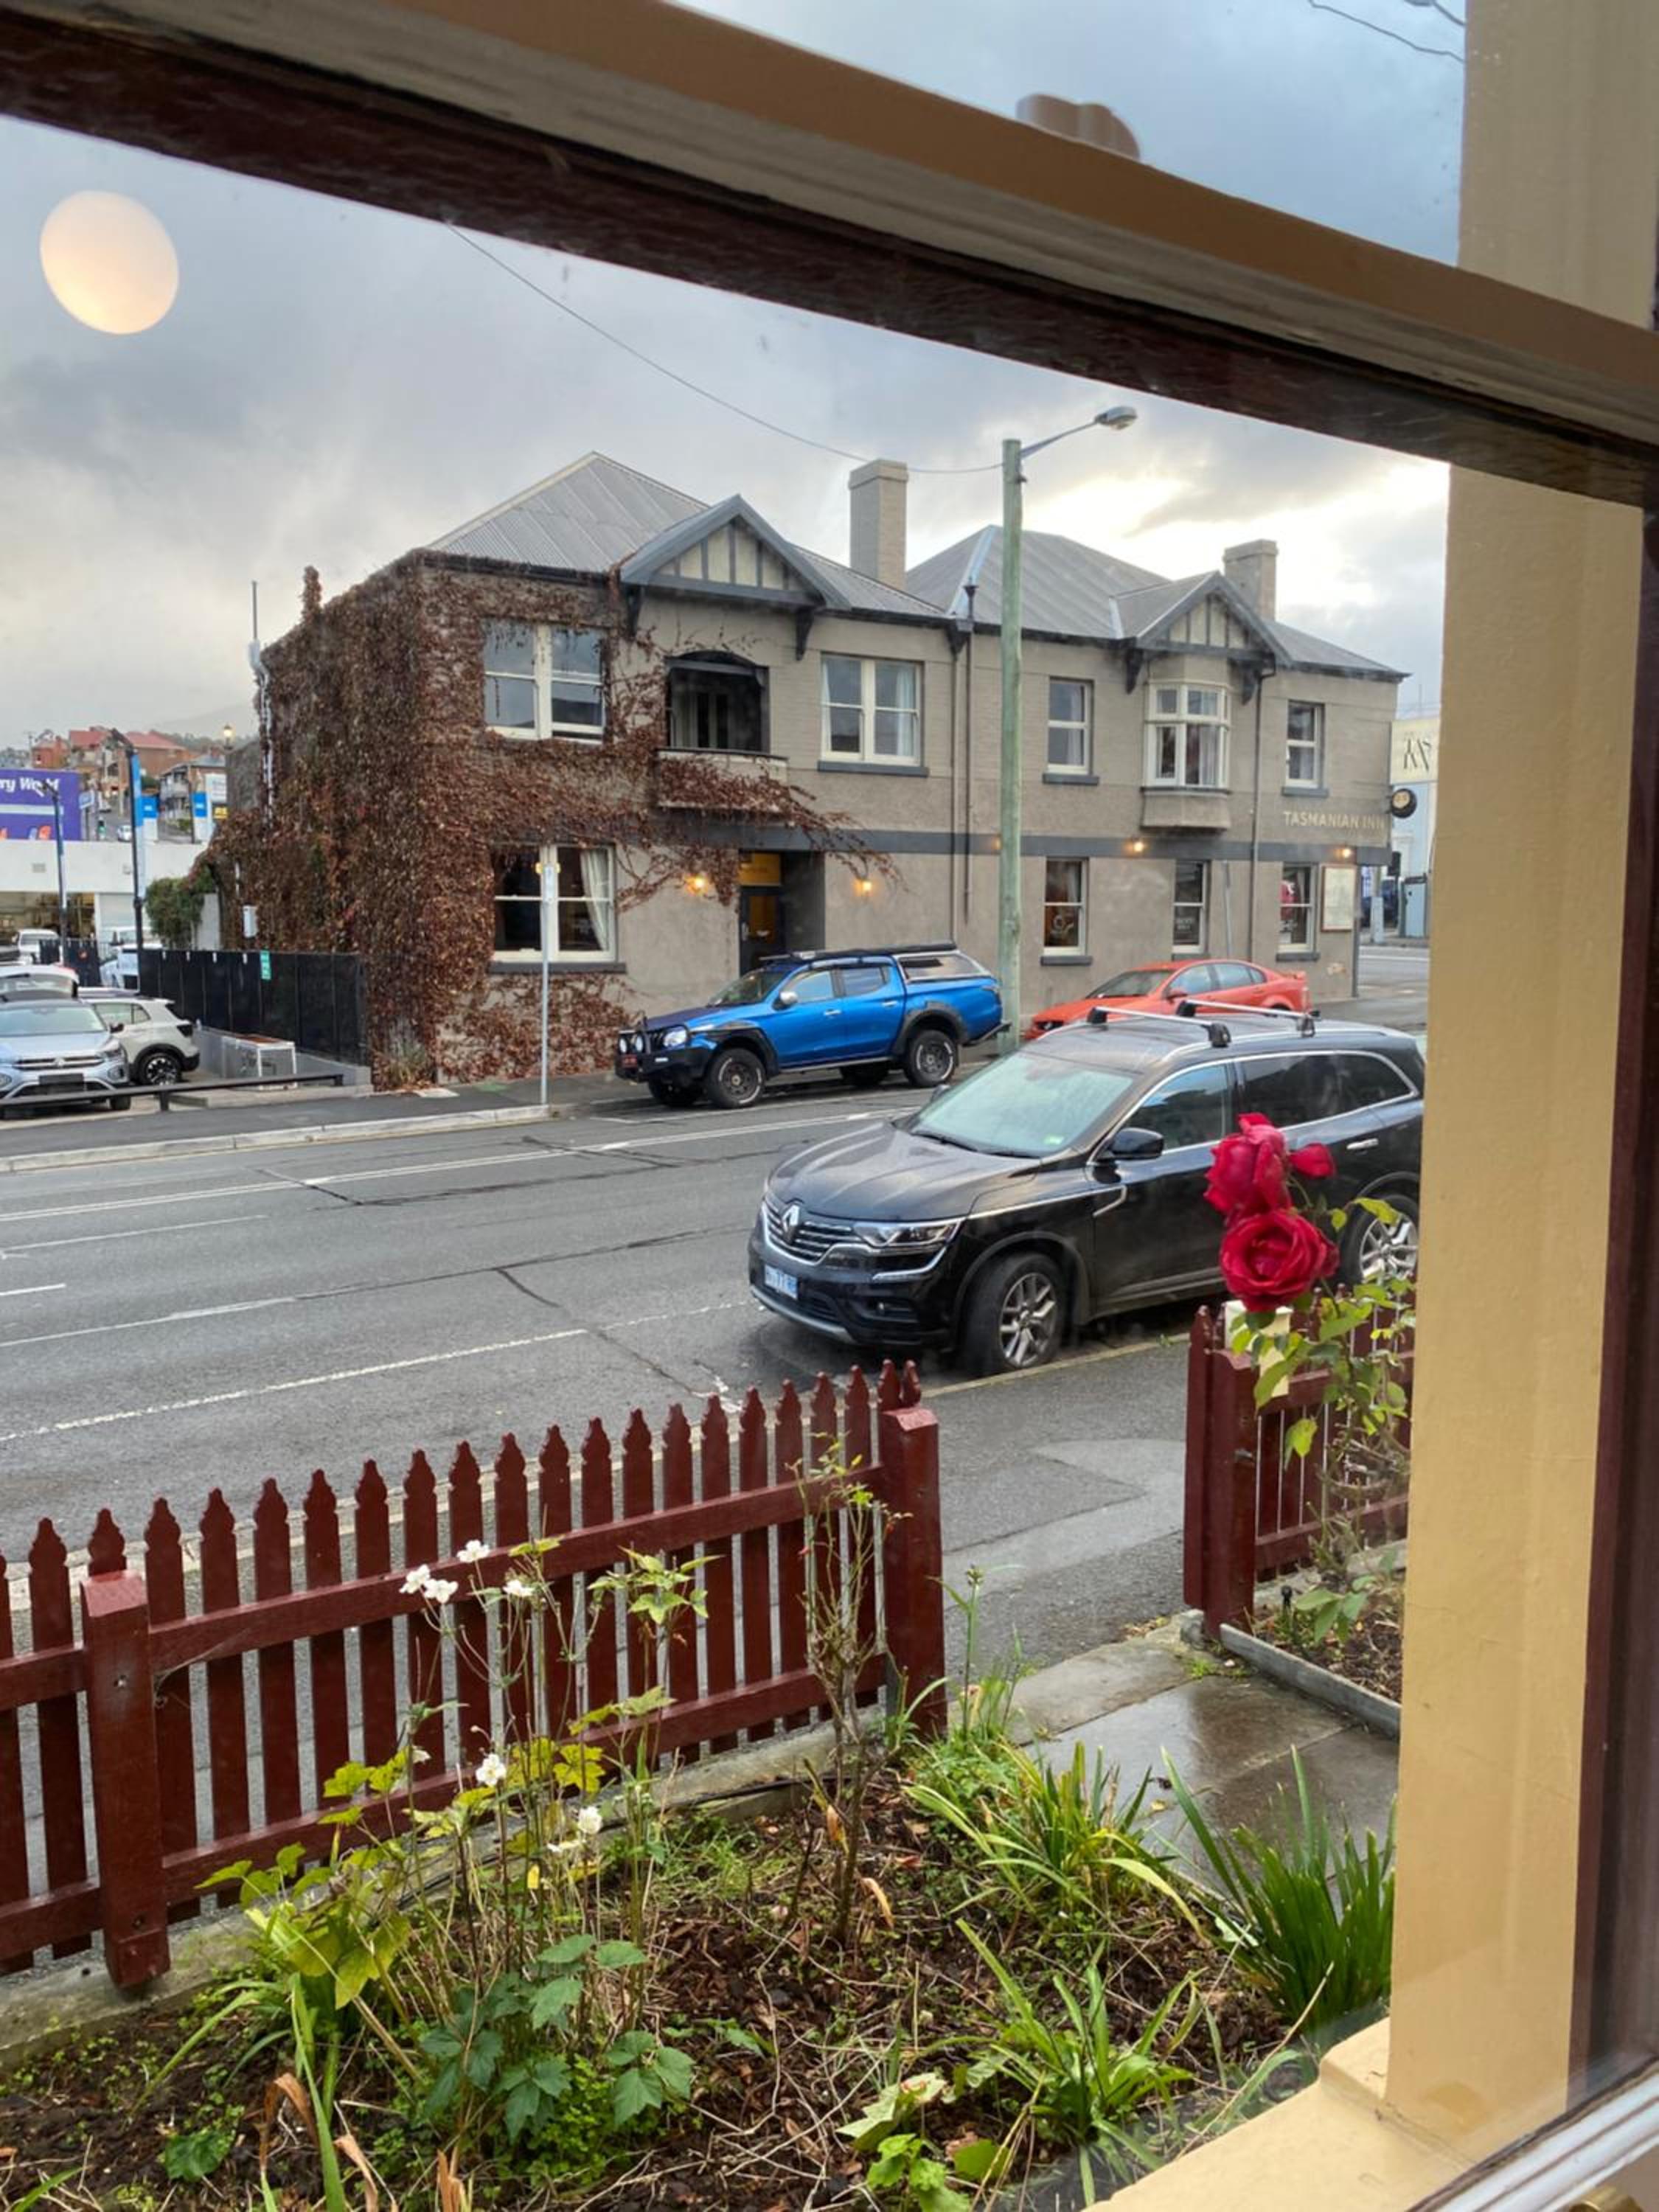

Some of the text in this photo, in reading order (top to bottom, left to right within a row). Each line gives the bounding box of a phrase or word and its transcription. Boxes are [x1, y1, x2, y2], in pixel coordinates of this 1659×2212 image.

[19, 777, 60, 791] Wold
[1284, 811, 1385, 830] TASMANIAN INN
